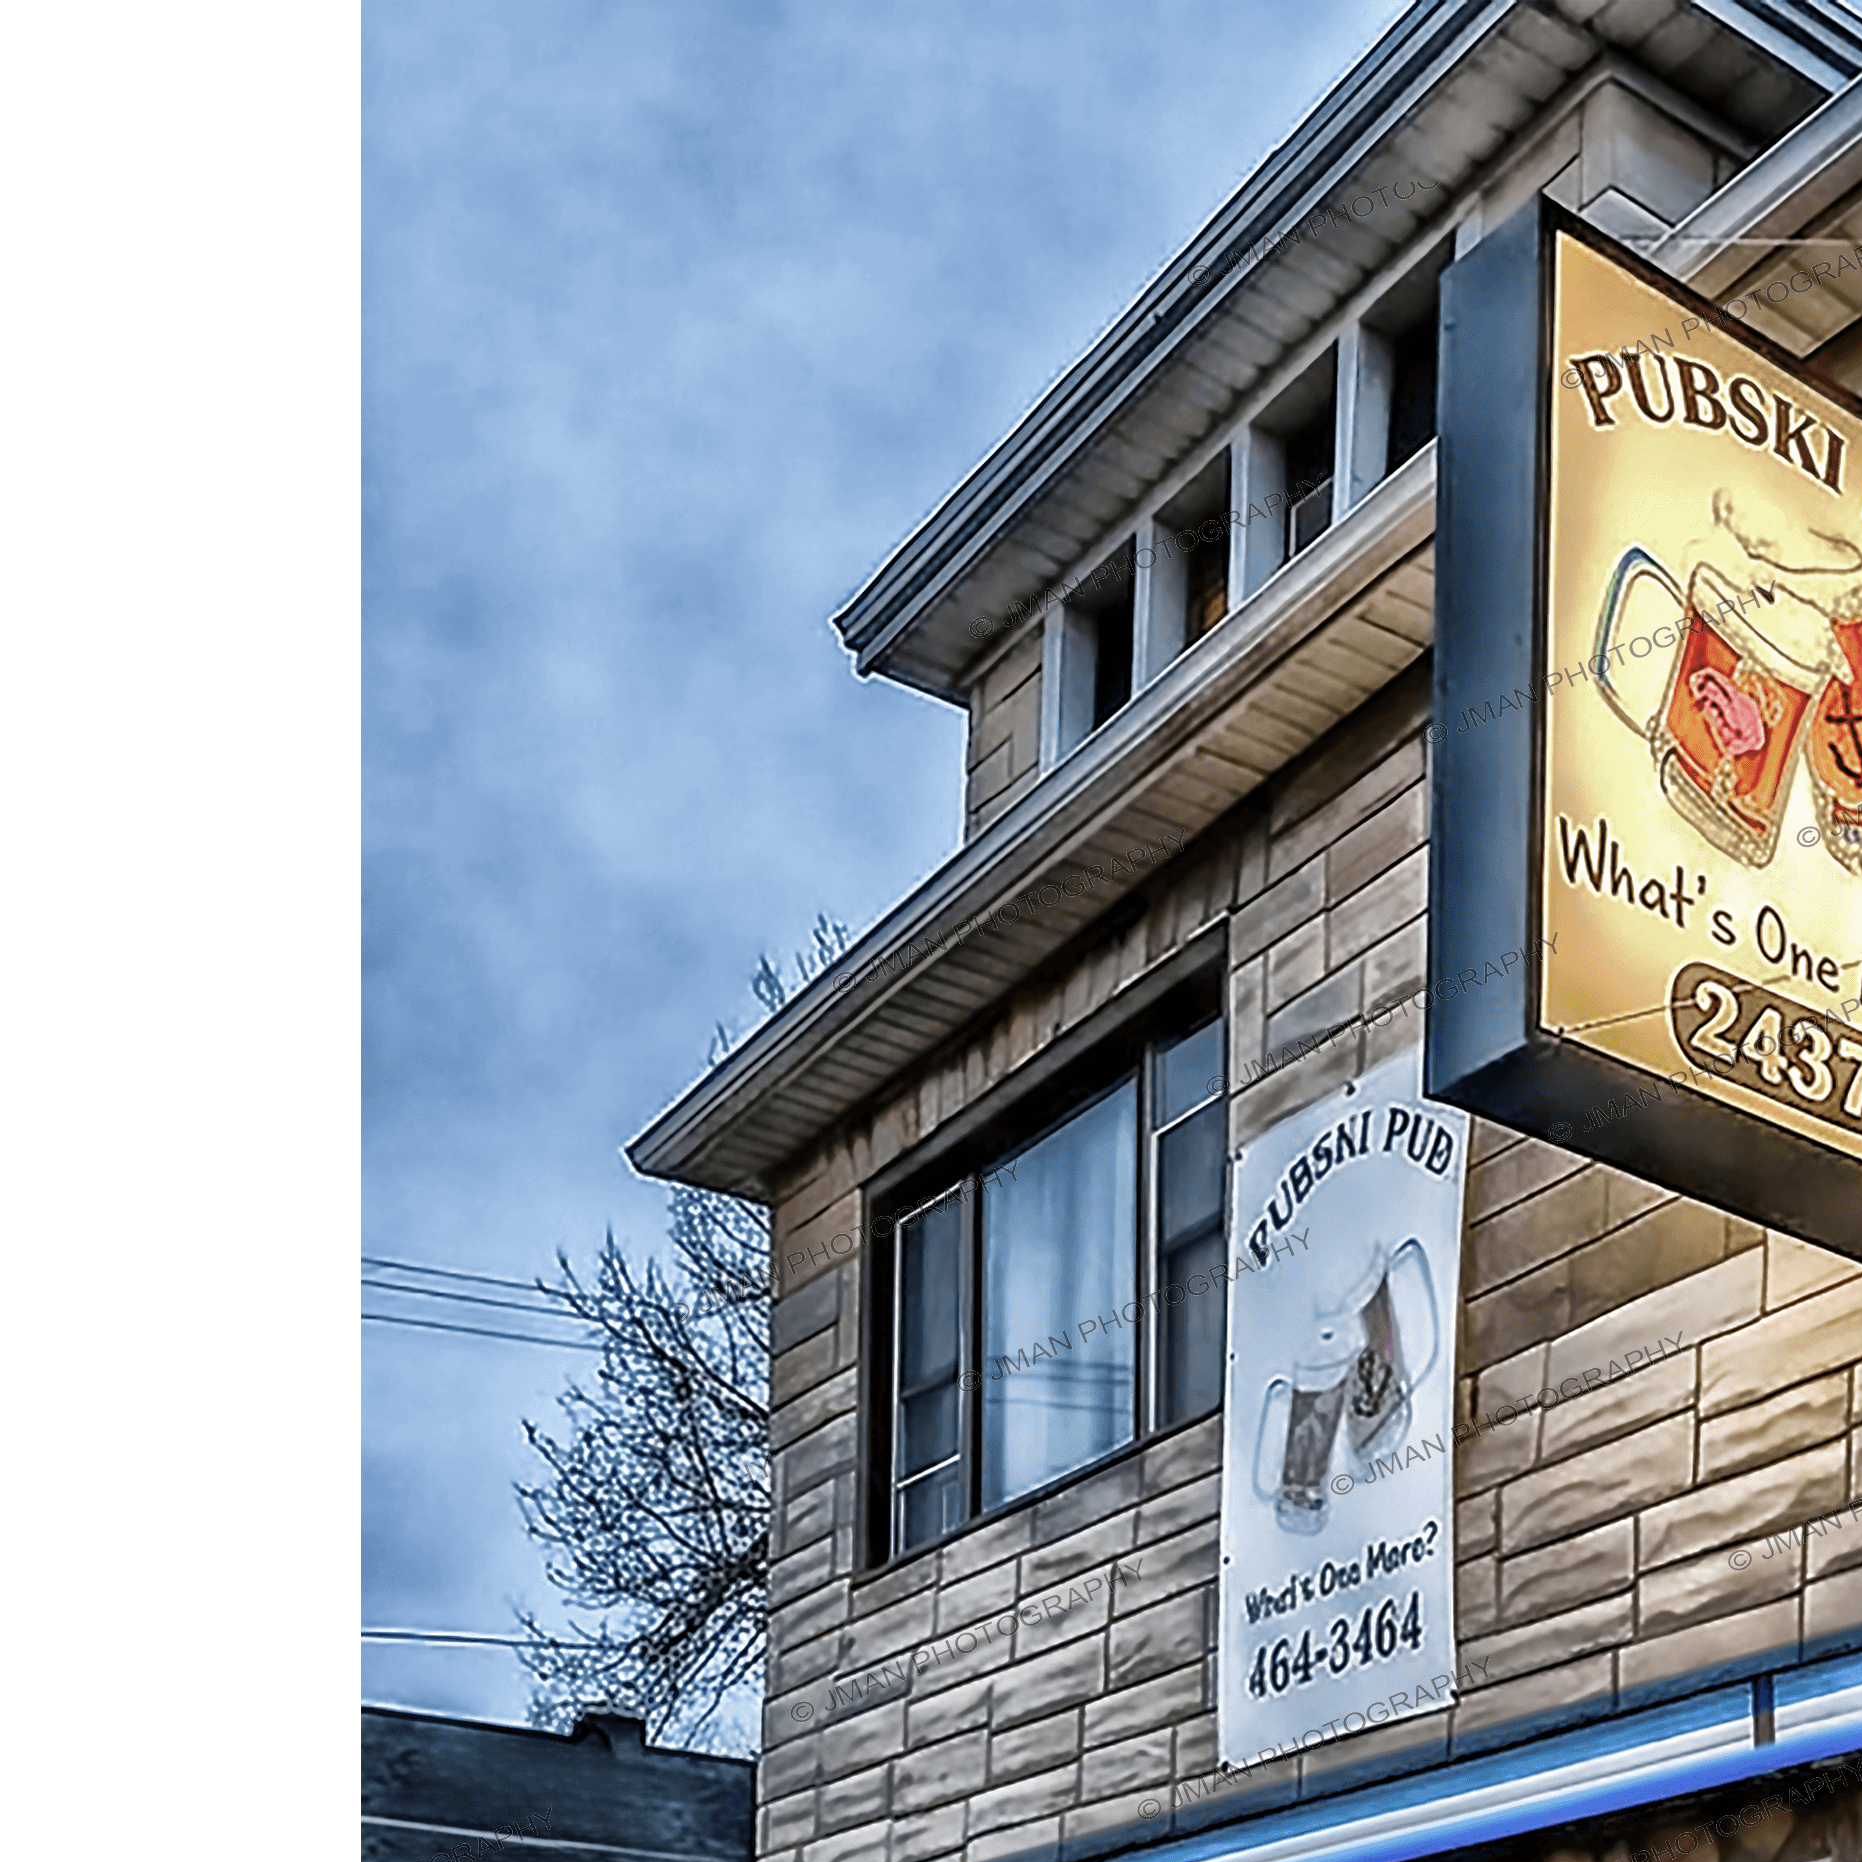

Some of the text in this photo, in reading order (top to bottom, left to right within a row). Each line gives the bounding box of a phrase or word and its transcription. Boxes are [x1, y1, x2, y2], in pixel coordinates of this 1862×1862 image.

[1570, 353, 1844, 494] PUBSKI
[1560, 815, 1737, 945] What's
[1757, 906, 1840, 992] One
[1382, 1107, 1453, 1176] PUB
[1249, 1590, 1422, 1697] 464-3464
